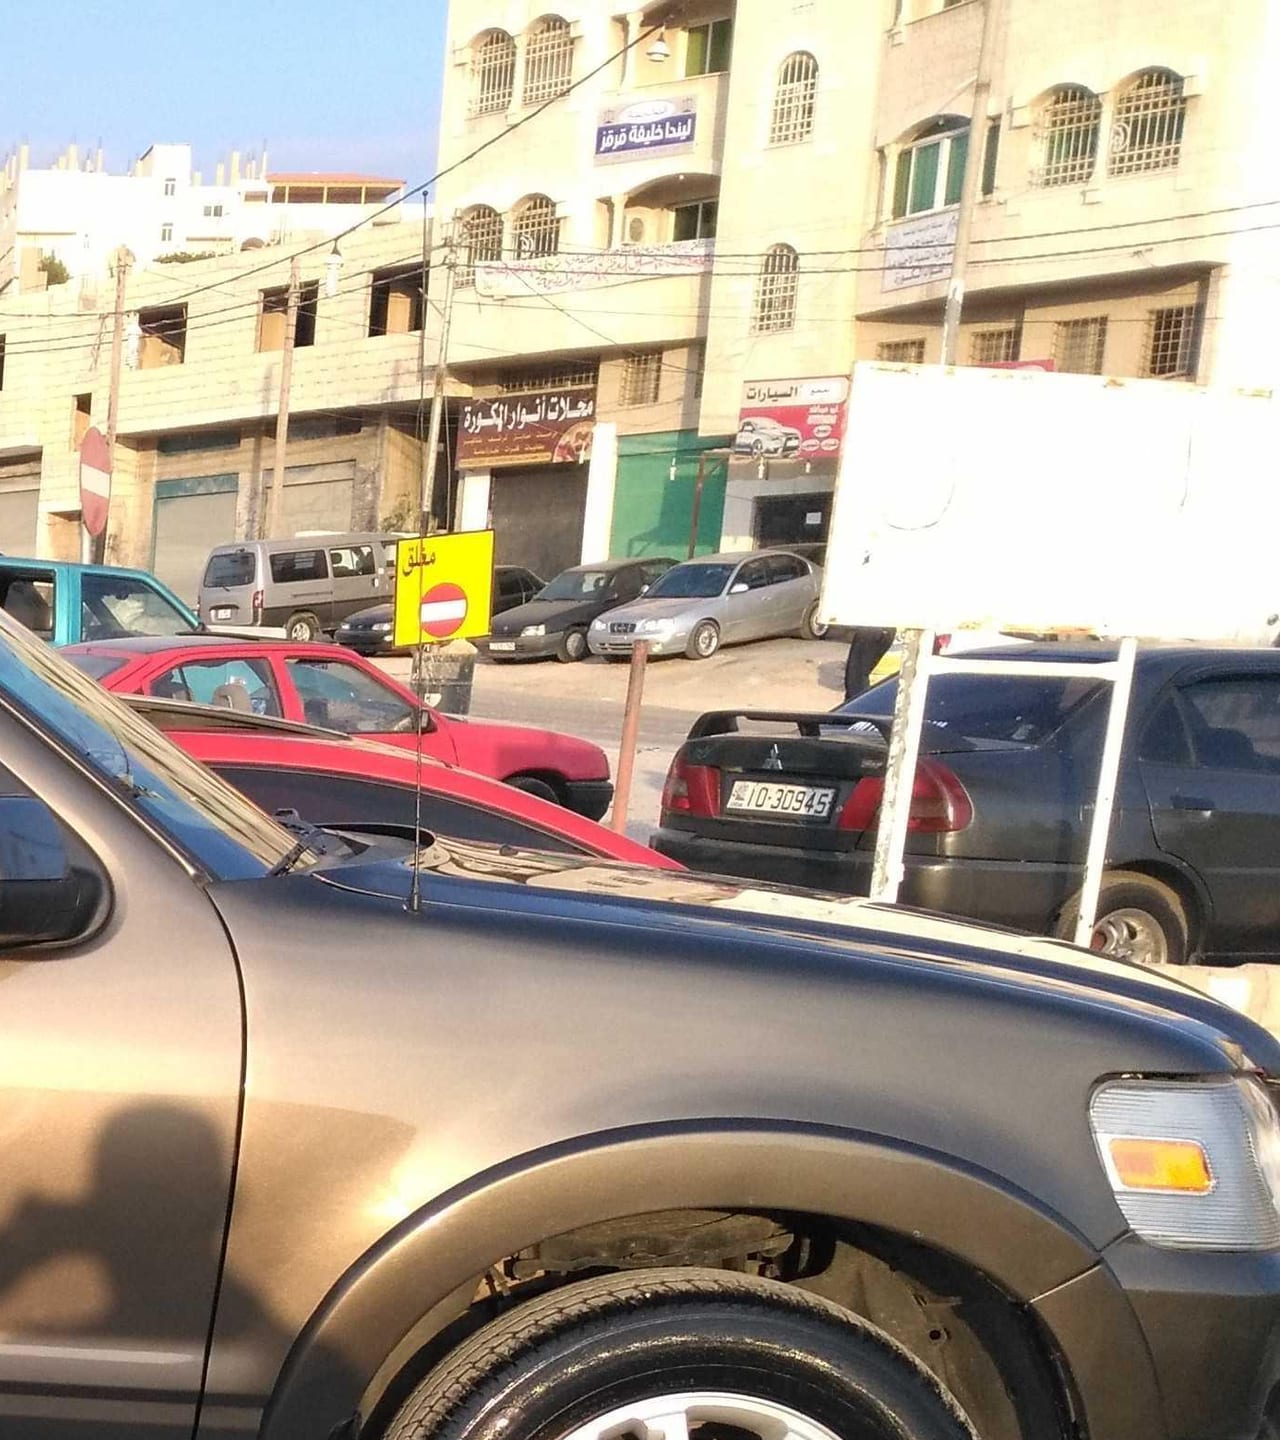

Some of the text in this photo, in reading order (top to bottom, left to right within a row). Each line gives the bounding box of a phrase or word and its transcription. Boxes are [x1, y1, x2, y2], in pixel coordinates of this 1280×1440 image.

[628, 123, 664, 145] خليفة
[746, 386, 798, 402] السيارات
[506, 395, 546, 430] أنوار
[547, 396, 593, 422] محلات
[402, 545, 436, 577] مغلق
